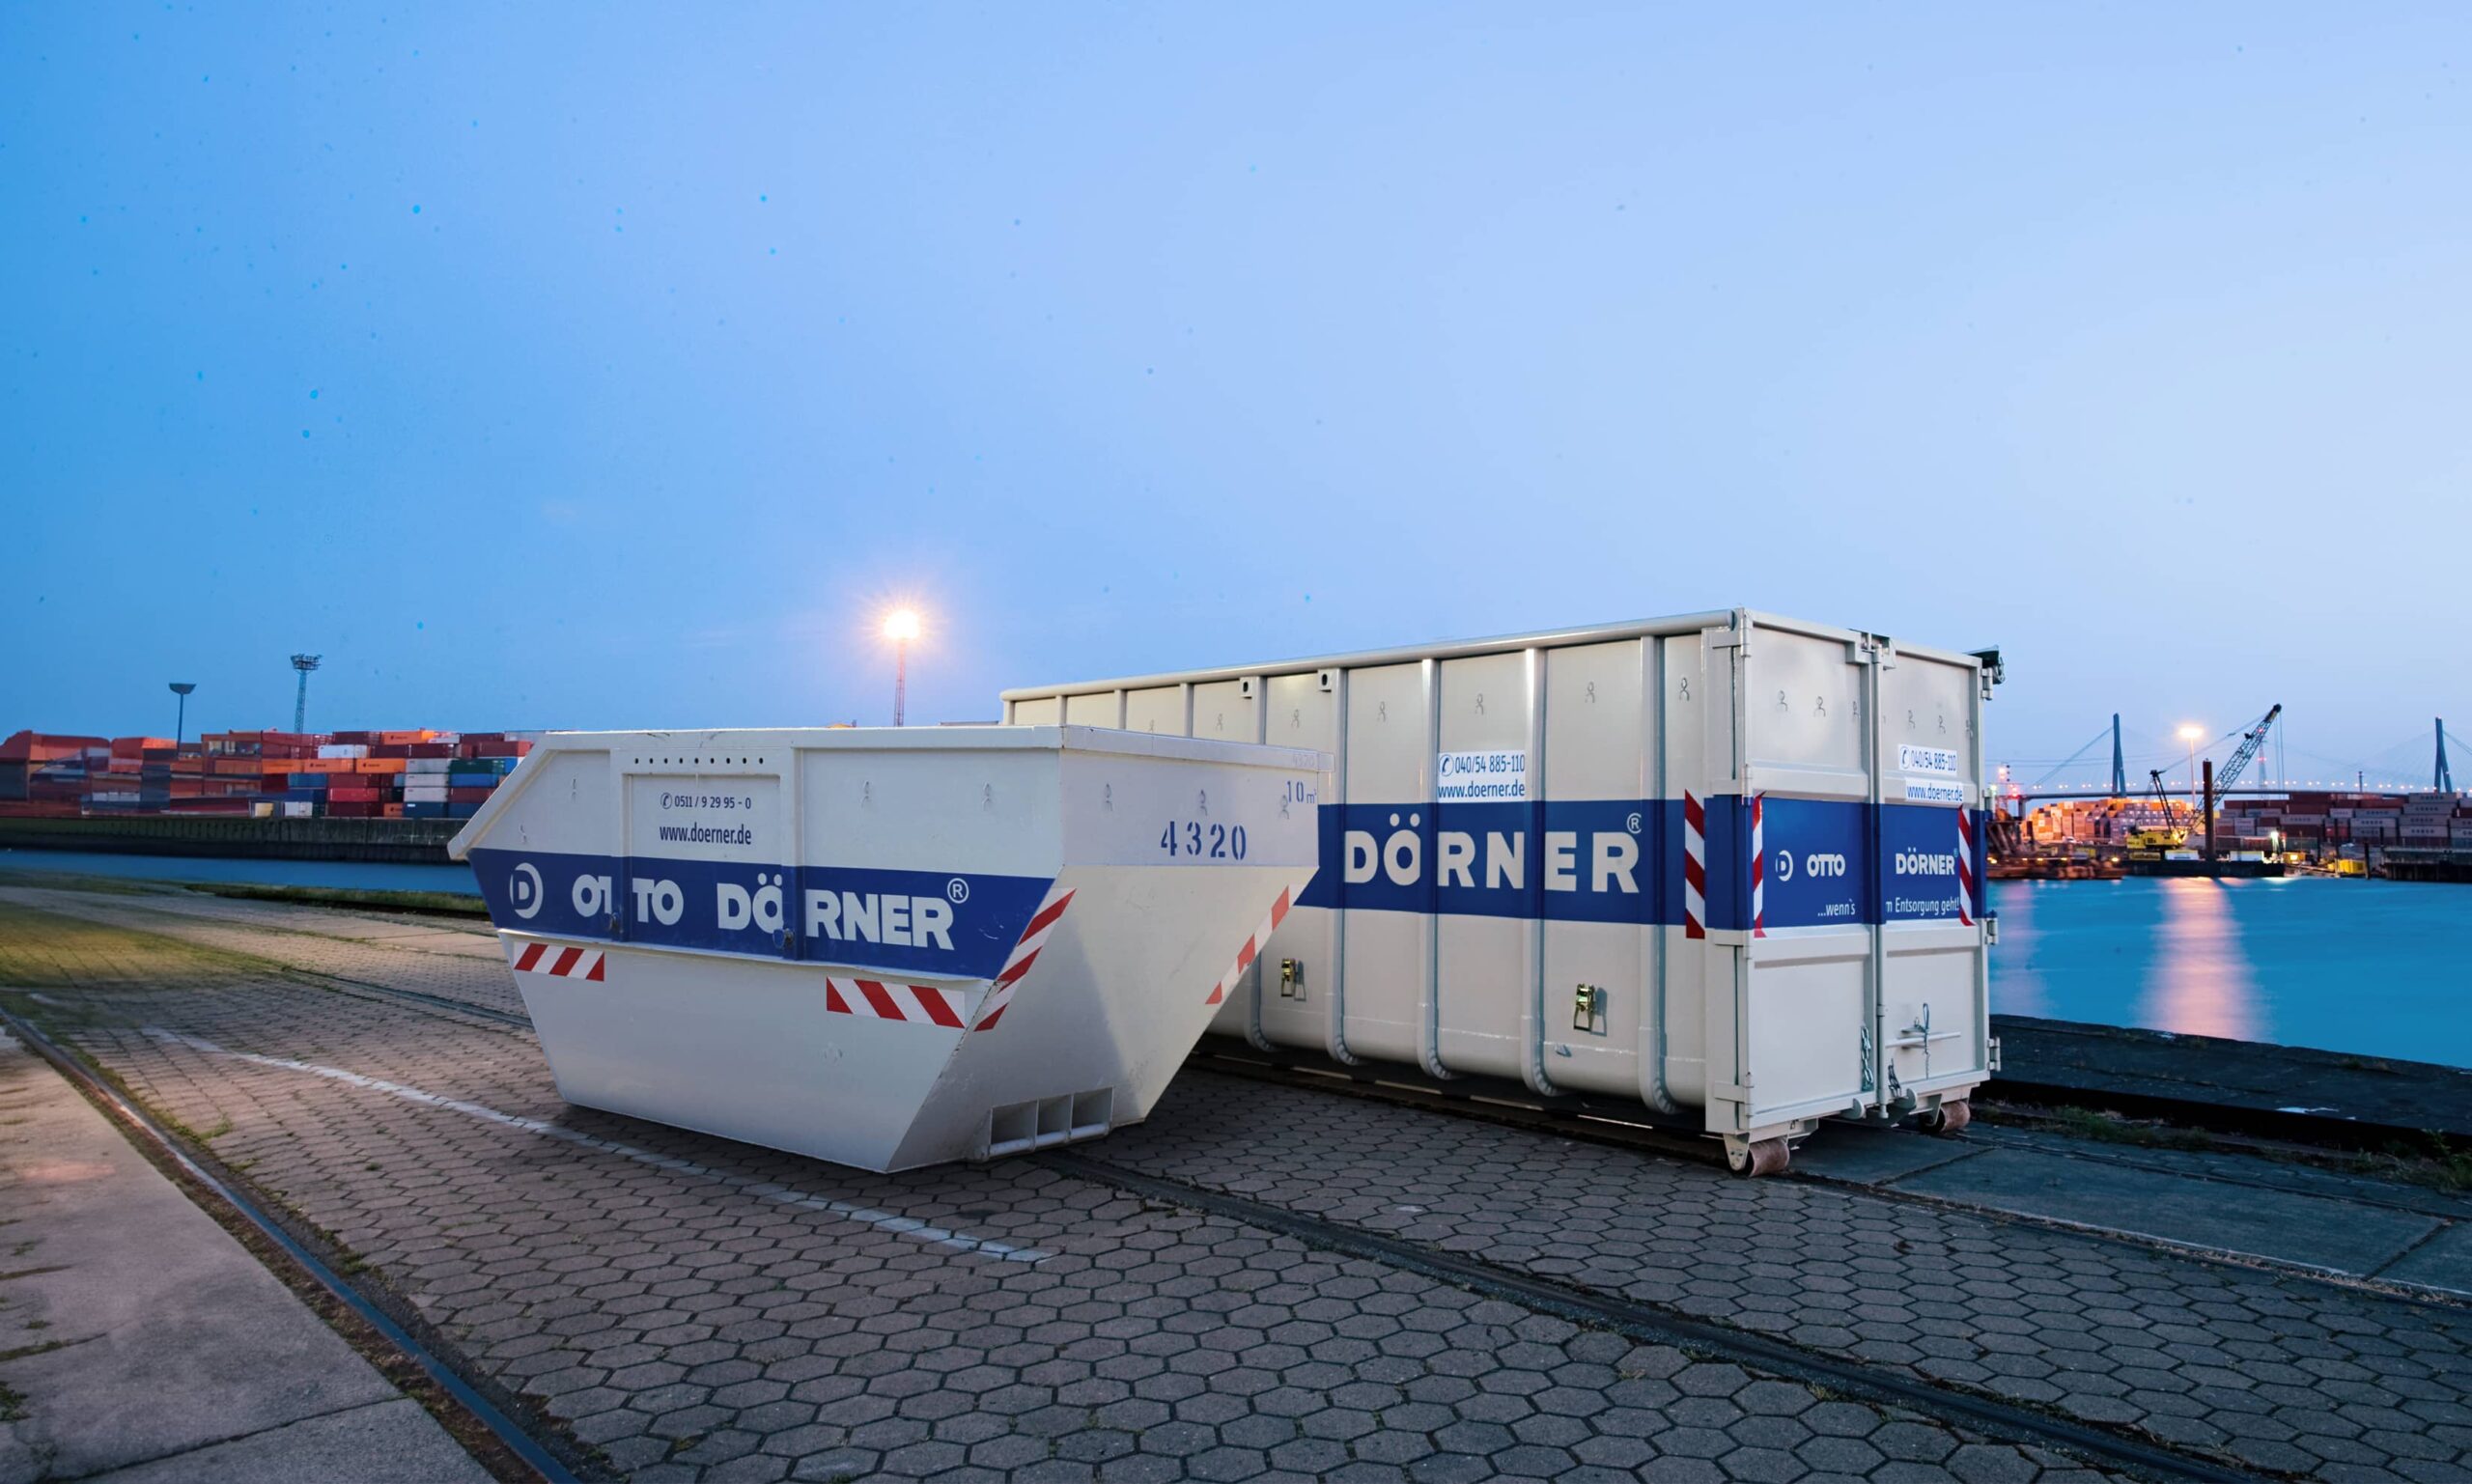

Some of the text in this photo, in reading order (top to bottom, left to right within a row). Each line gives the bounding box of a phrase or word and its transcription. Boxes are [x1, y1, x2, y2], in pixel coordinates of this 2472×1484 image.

[1454, 753, 1526, 774] 040/54 885-110
[1437, 779, 1526, 798] www.doerner.de
[1906, 782, 1963, 802] www.doerner.de
[674, 795, 693, 808] 0511
[701, 796, 708, 808] 9
[710, 797, 721, 808] 29
[723, 797, 735, 809] 95
[744, 798, 751, 810] 0
[660, 822, 751, 845] www.doerner.de
[1161, 821, 1247, 860] 4320
[1807, 854, 1846, 878] OTTO
[1895, 896, 1939, 916] Entsorgung
